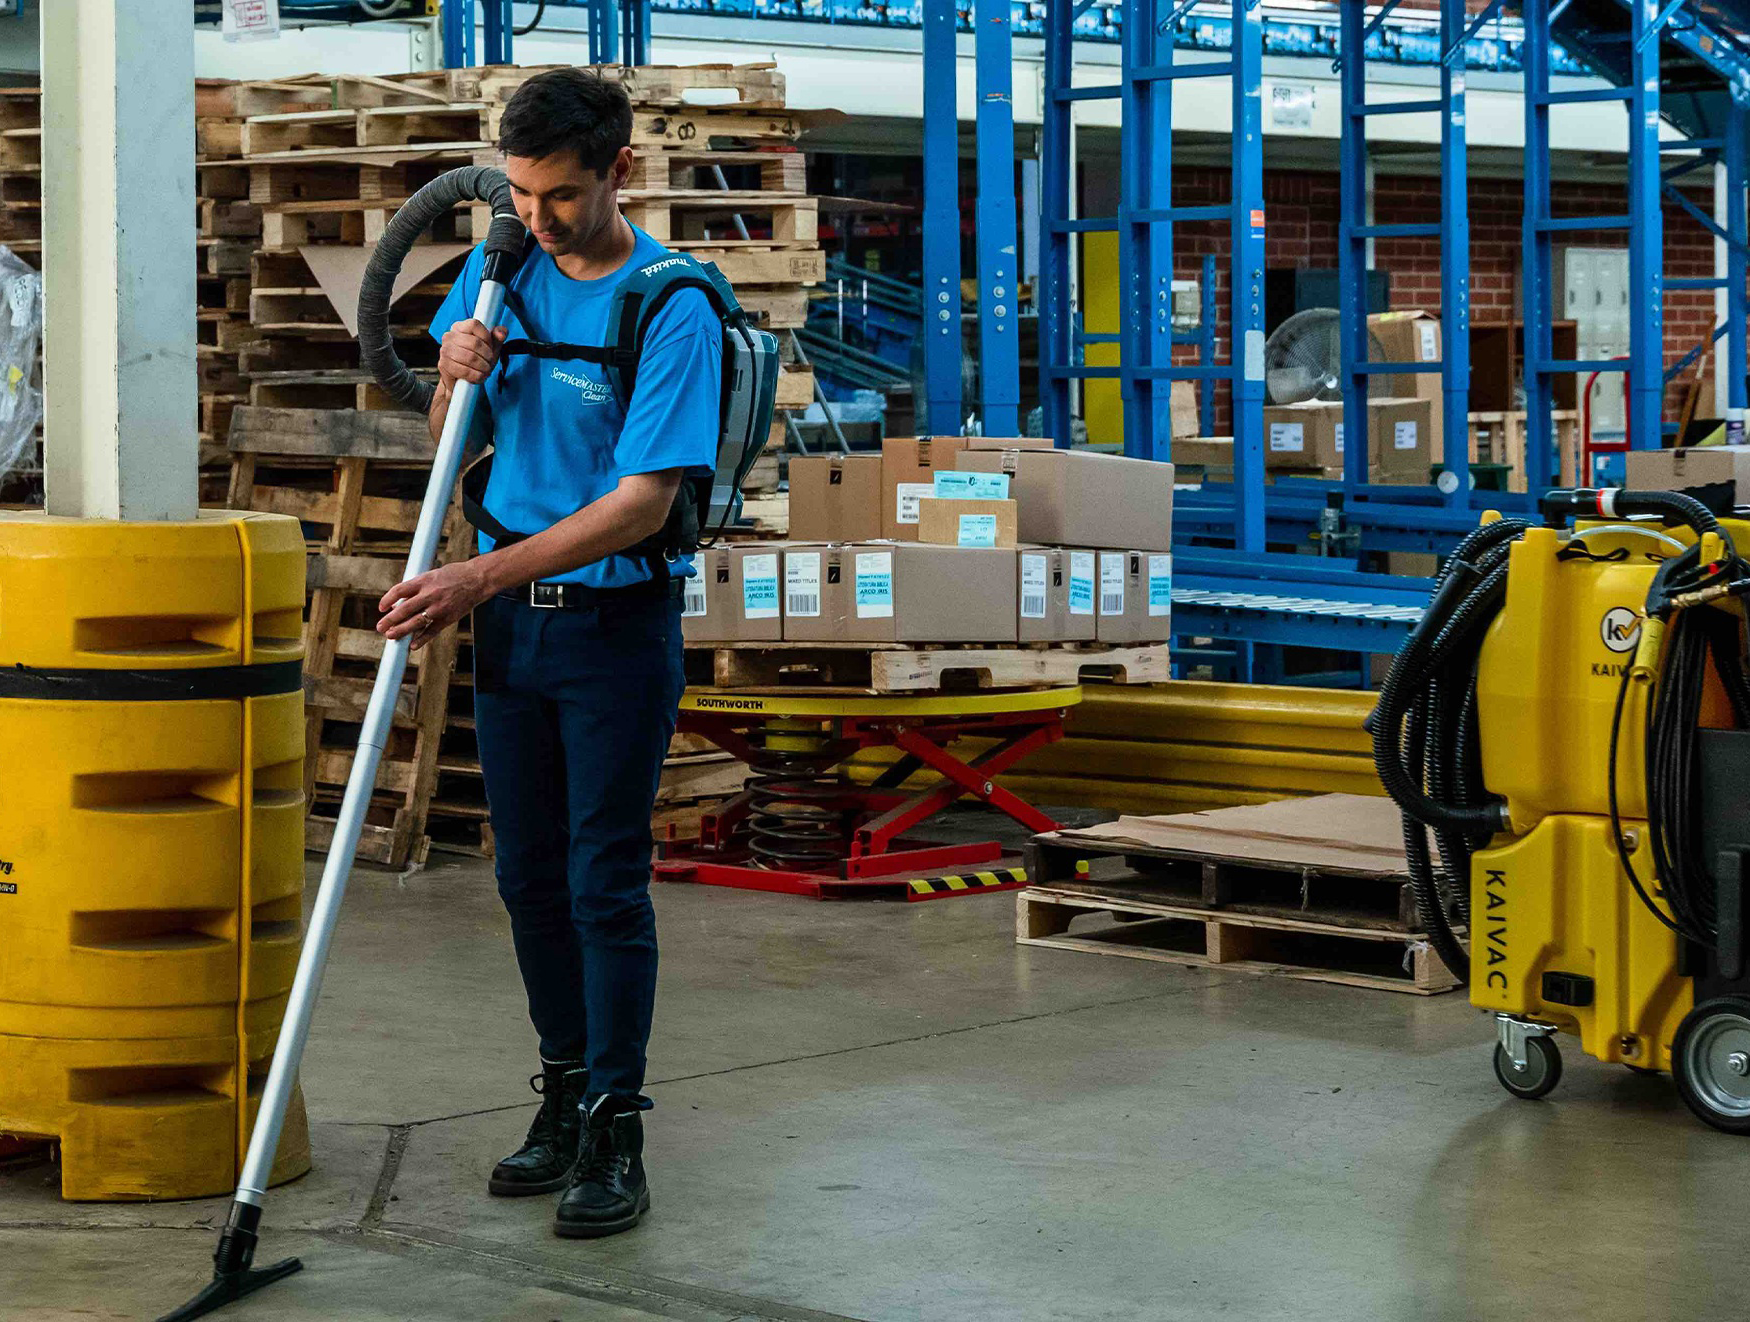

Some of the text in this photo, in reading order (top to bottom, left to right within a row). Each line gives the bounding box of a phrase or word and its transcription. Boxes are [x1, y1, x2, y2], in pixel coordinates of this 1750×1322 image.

[583, 391, 606, 401] Clean
[1591, 663, 1628, 677] KAIV
[696, 698, 763, 709] SOUTHWORTH
[1485, 869, 1508, 989] KAIVAC
